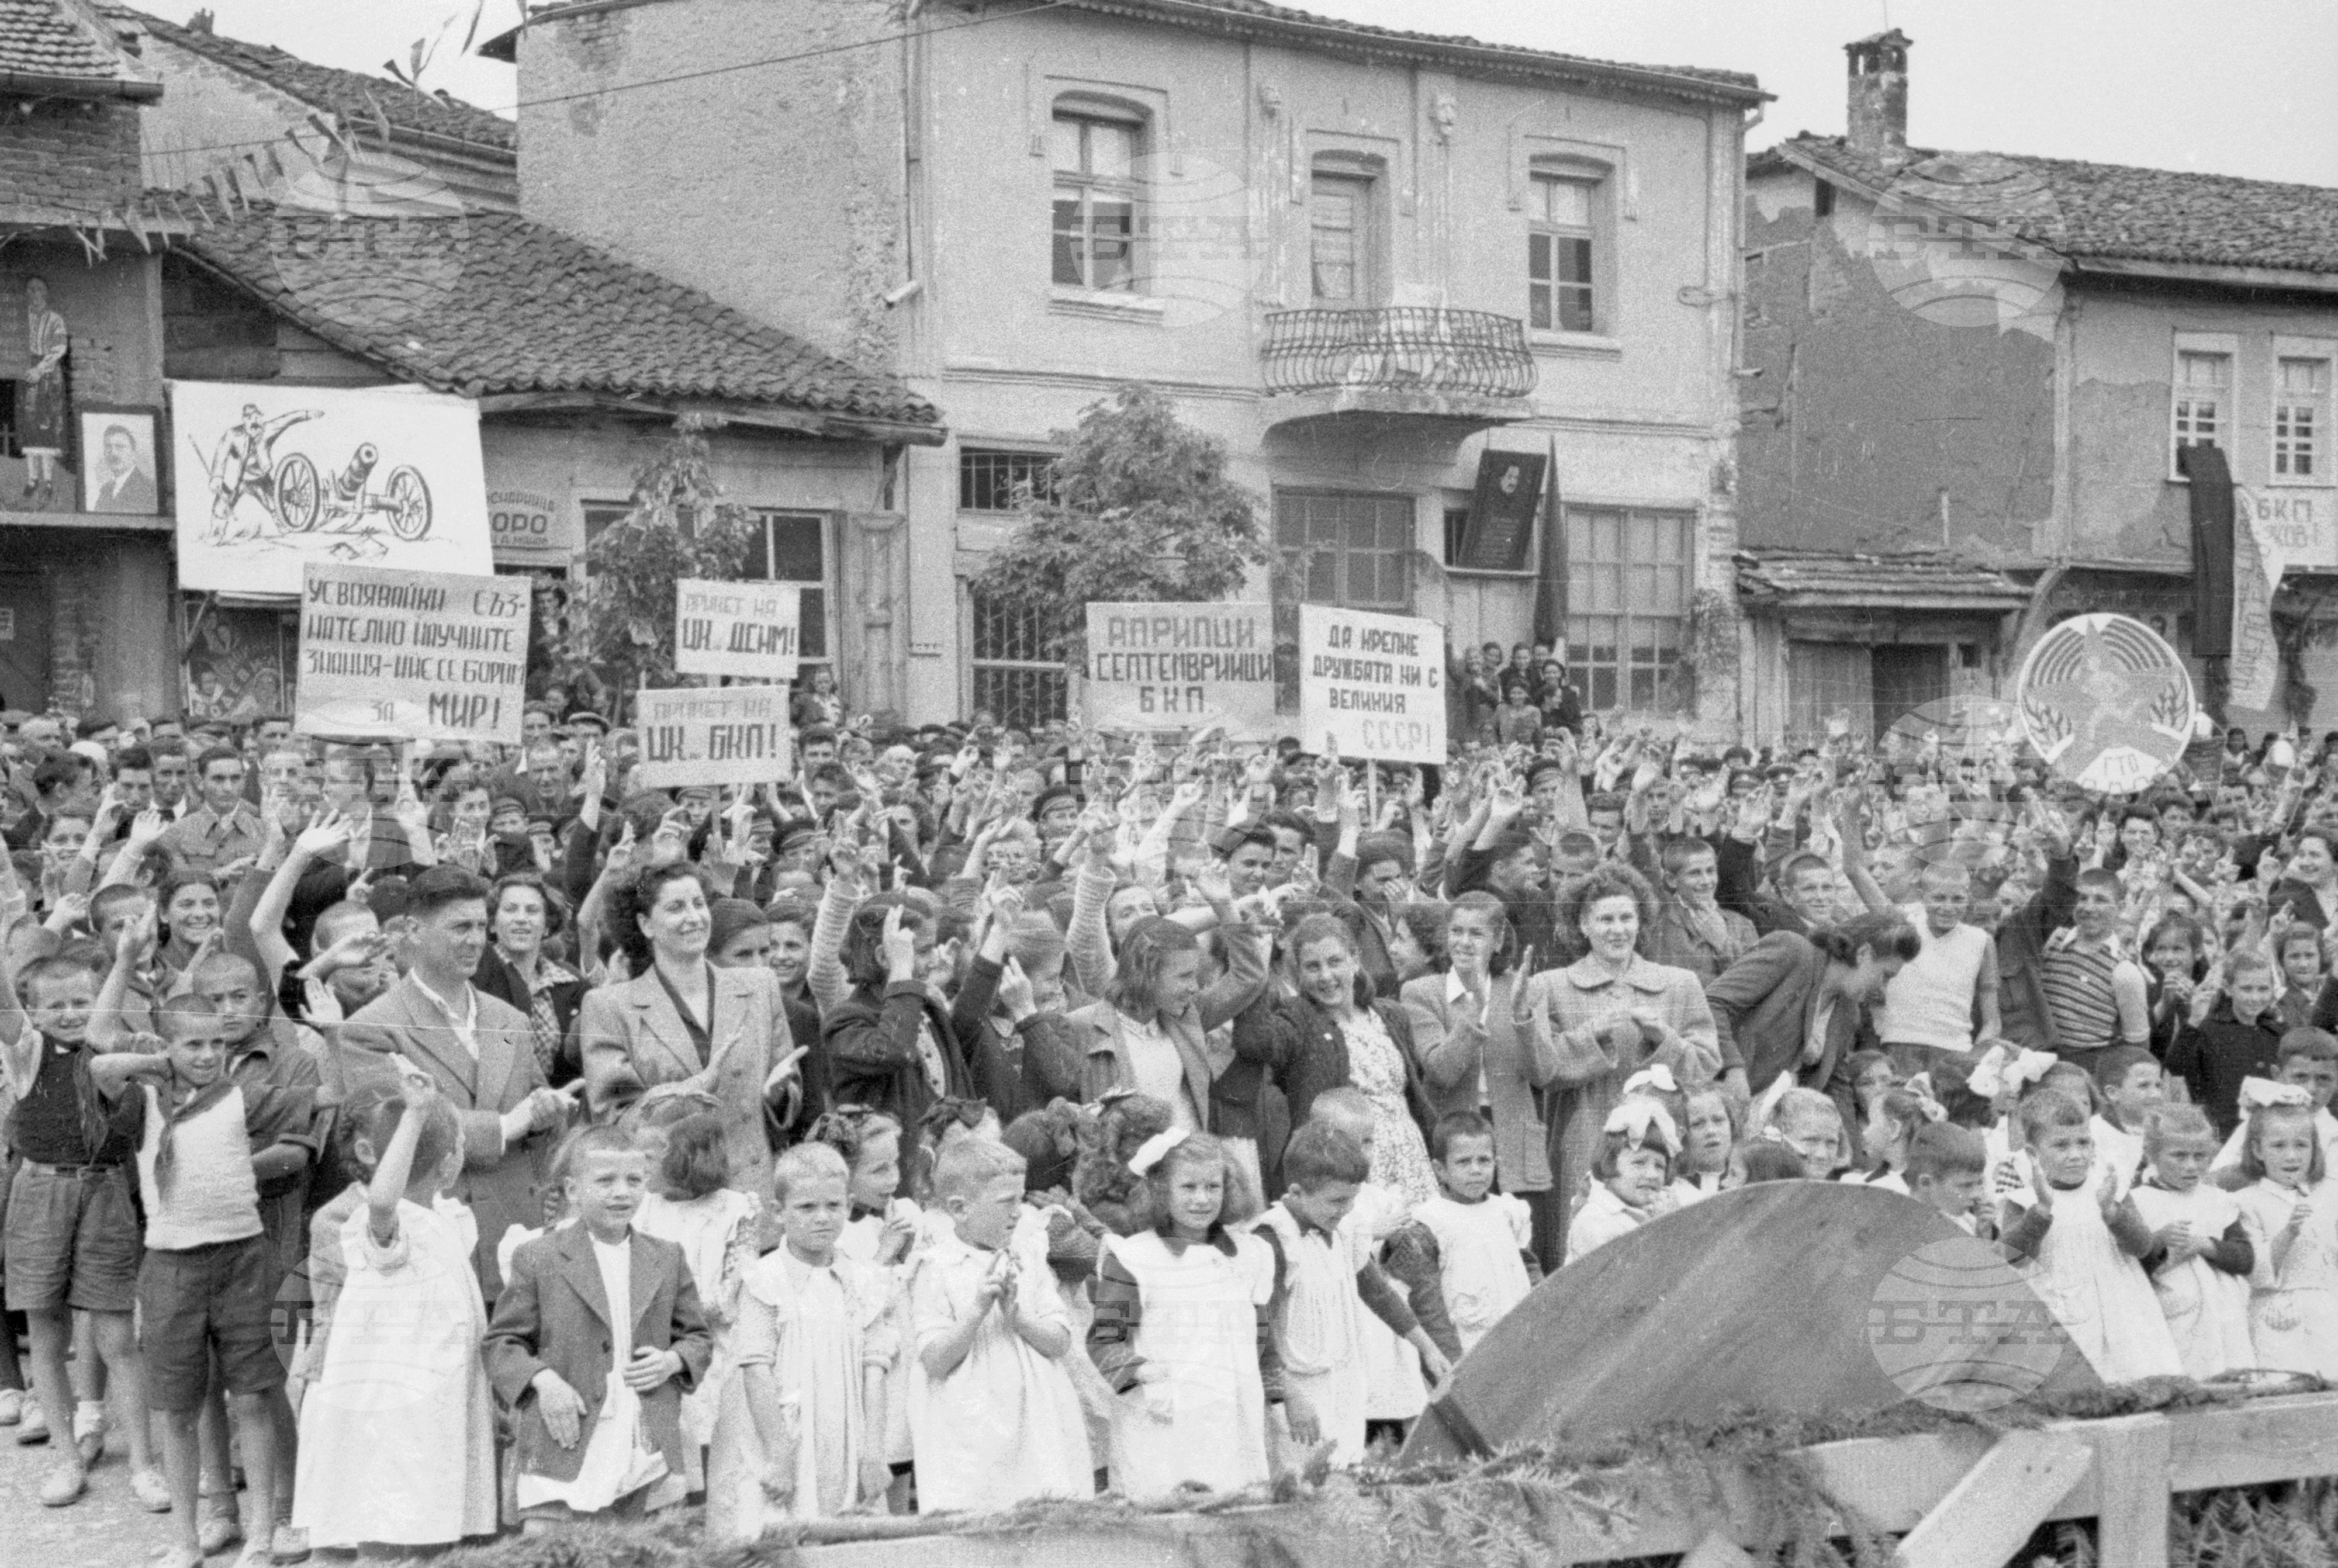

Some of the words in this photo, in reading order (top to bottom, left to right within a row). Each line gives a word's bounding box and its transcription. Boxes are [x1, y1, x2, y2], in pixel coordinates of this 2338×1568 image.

[490, 513, 548, 534] ОРО
[2257, 498, 2311, 522] БКП
[309, 578, 445, 611] УСВОЯВАЙКИ
[473, 589, 525, 617] СЪЗ-
[307, 615, 406, 646] НАТЕЛНО
[413, 621, 515, 652] НАУЧНИТЕ
[1327, 625, 1352, 649] ДА
[1361, 628, 1419, 656] КРЕПНЕ
[462, 659, 525, 686] БОРИМ
[1313, 655, 1392, 684] ДРУЖБАТА
[1399, 664, 1421, 686] НИ
[1429, 667, 1438, 688] С
[370, 701, 395, 723] ЗА
[428, 691, 501, 729] МИР!
[1329, 687, 1406, 714] ВЕЛИКИЯ
[708, 722, 777, 761] БКП!
[1362, 719, 1431, 753] СССР!
[2104, 753, 2139, 777] ГТО
